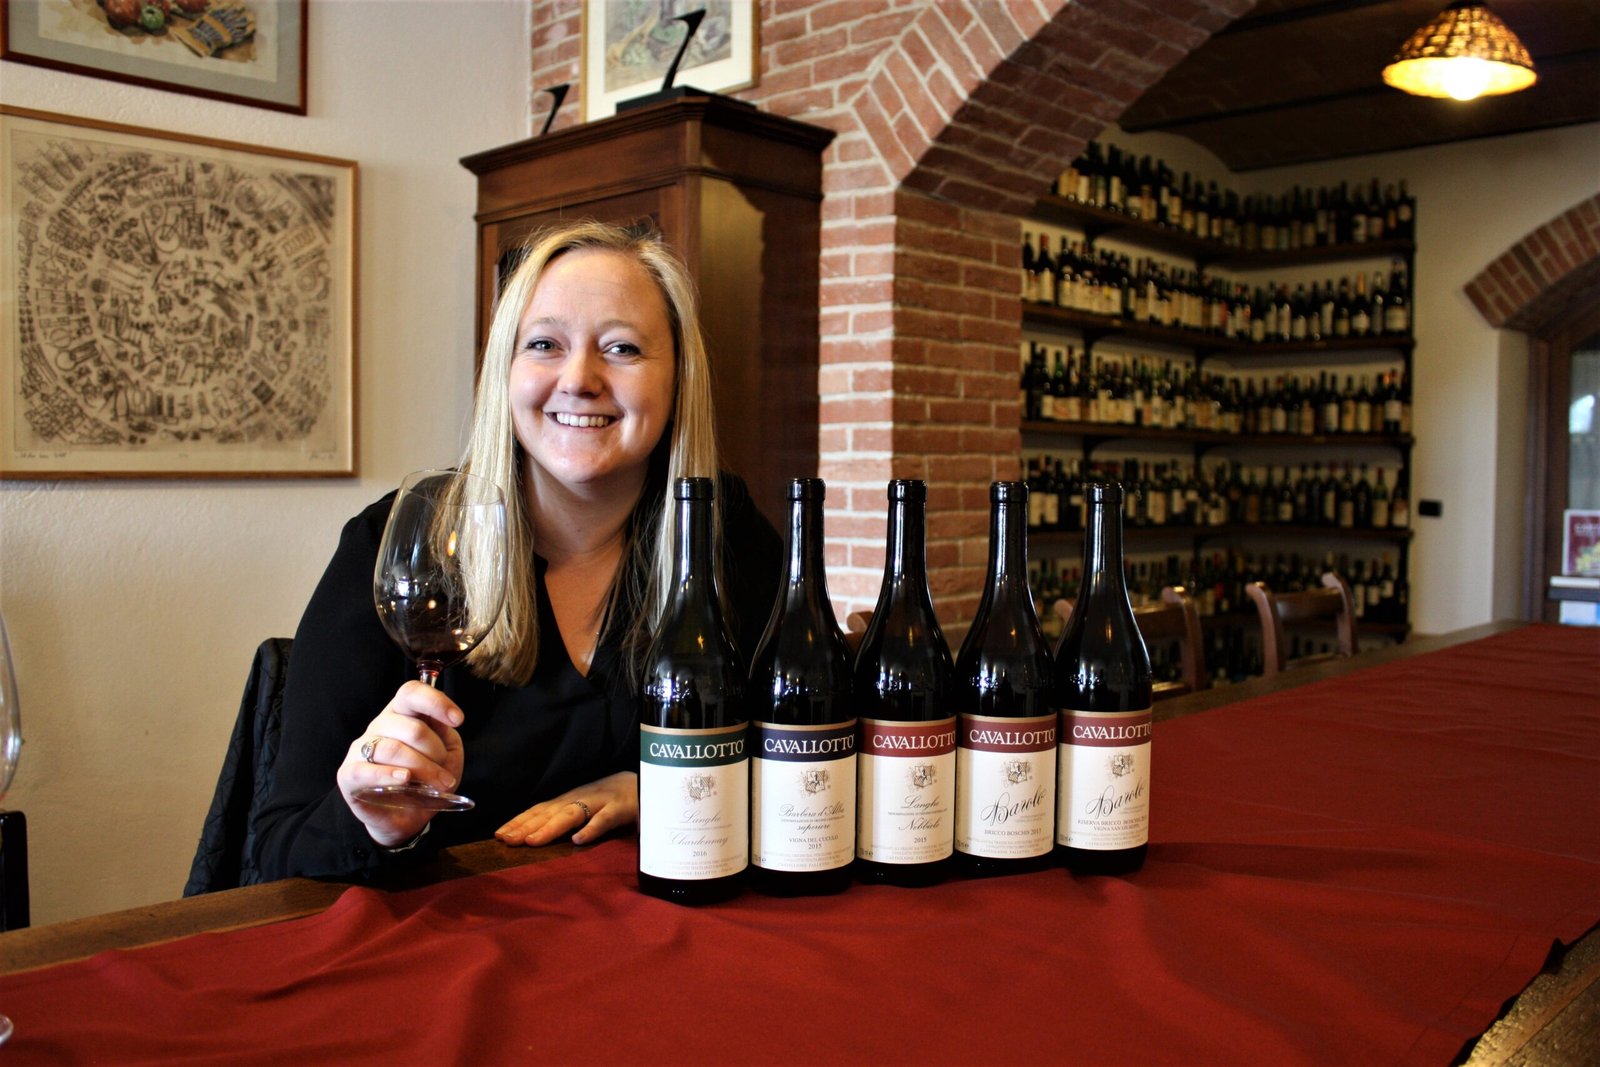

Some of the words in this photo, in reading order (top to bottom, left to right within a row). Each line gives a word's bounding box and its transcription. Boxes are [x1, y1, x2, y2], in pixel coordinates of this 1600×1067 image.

[764, 734, 854, 754] CAVALLOTTO
[969, 728, 1055, 745] CAVALLOTTO
[649, 739, 744, 759] CAVALLOTTO
[692, 850, 708, 858] 2016
